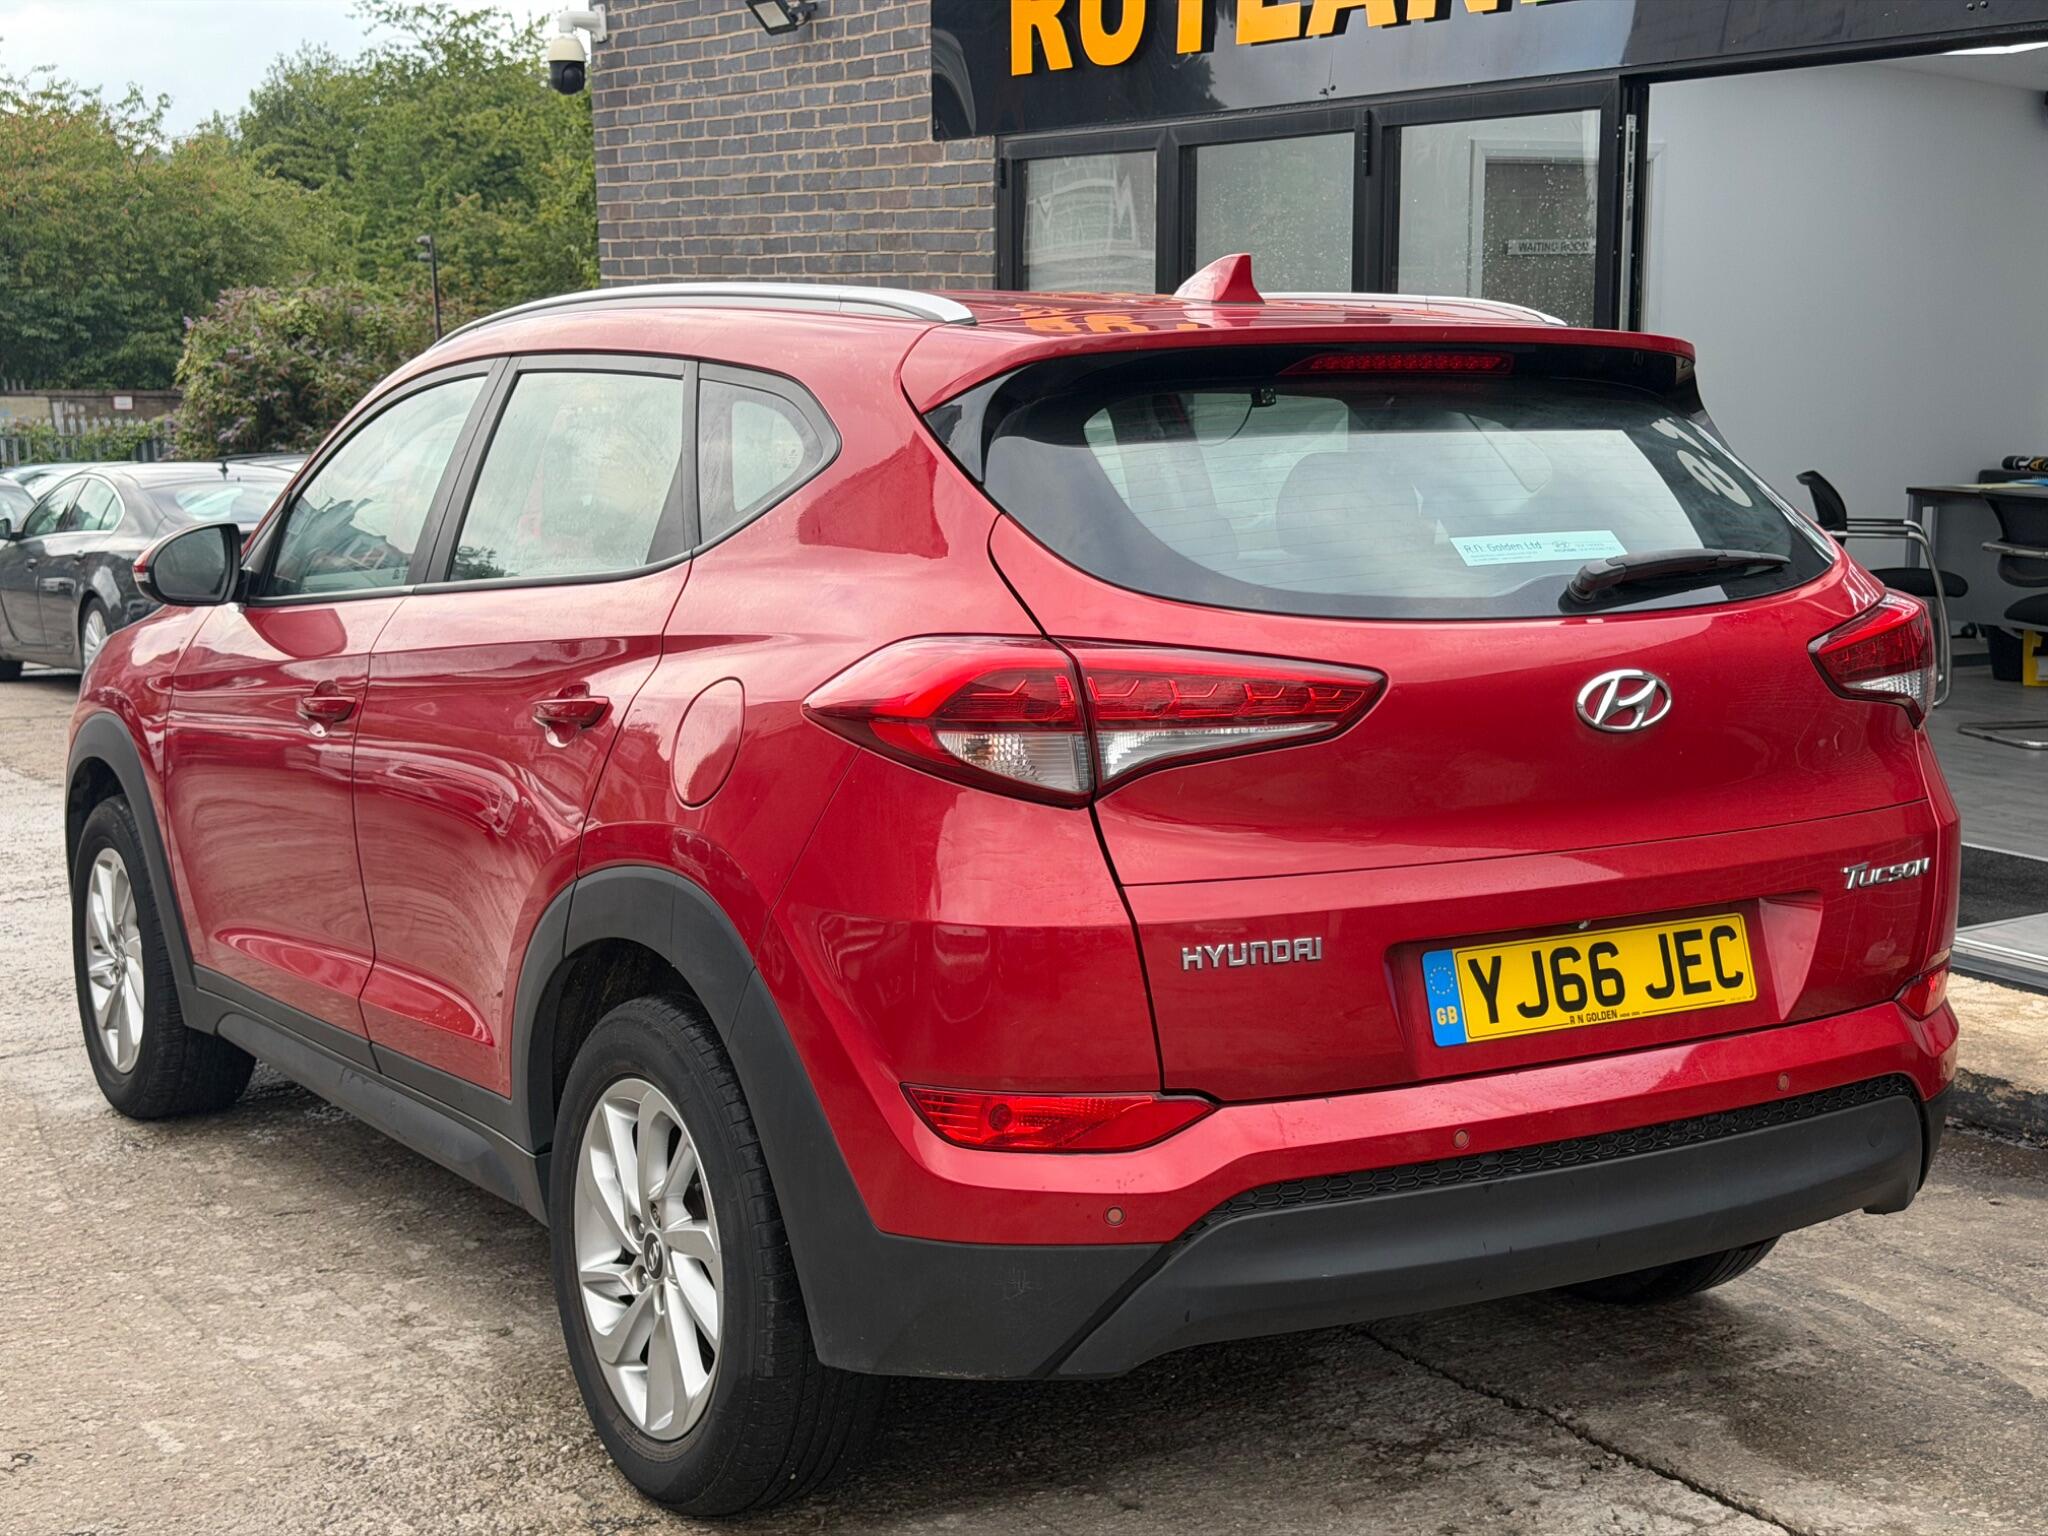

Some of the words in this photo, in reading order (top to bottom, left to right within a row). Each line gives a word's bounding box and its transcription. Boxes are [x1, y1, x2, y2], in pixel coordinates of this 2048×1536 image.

[1518, 241, 1557, 252] WAITING
[1487, 542, 1523, 552] Golden
[1524, 540, 1543, 551] Ltd
[1181, 936, 1323, 971] HYUNDAI
[1467, 940, 1626, 1025] YJ66
[1645, 925, 1745, 1000] JEC
[1435, 1006, 1458, 1026] GB
[1577, 1014, 1584, 1024] N
[1586, 1009, 1618, 1023] GOLDEN
